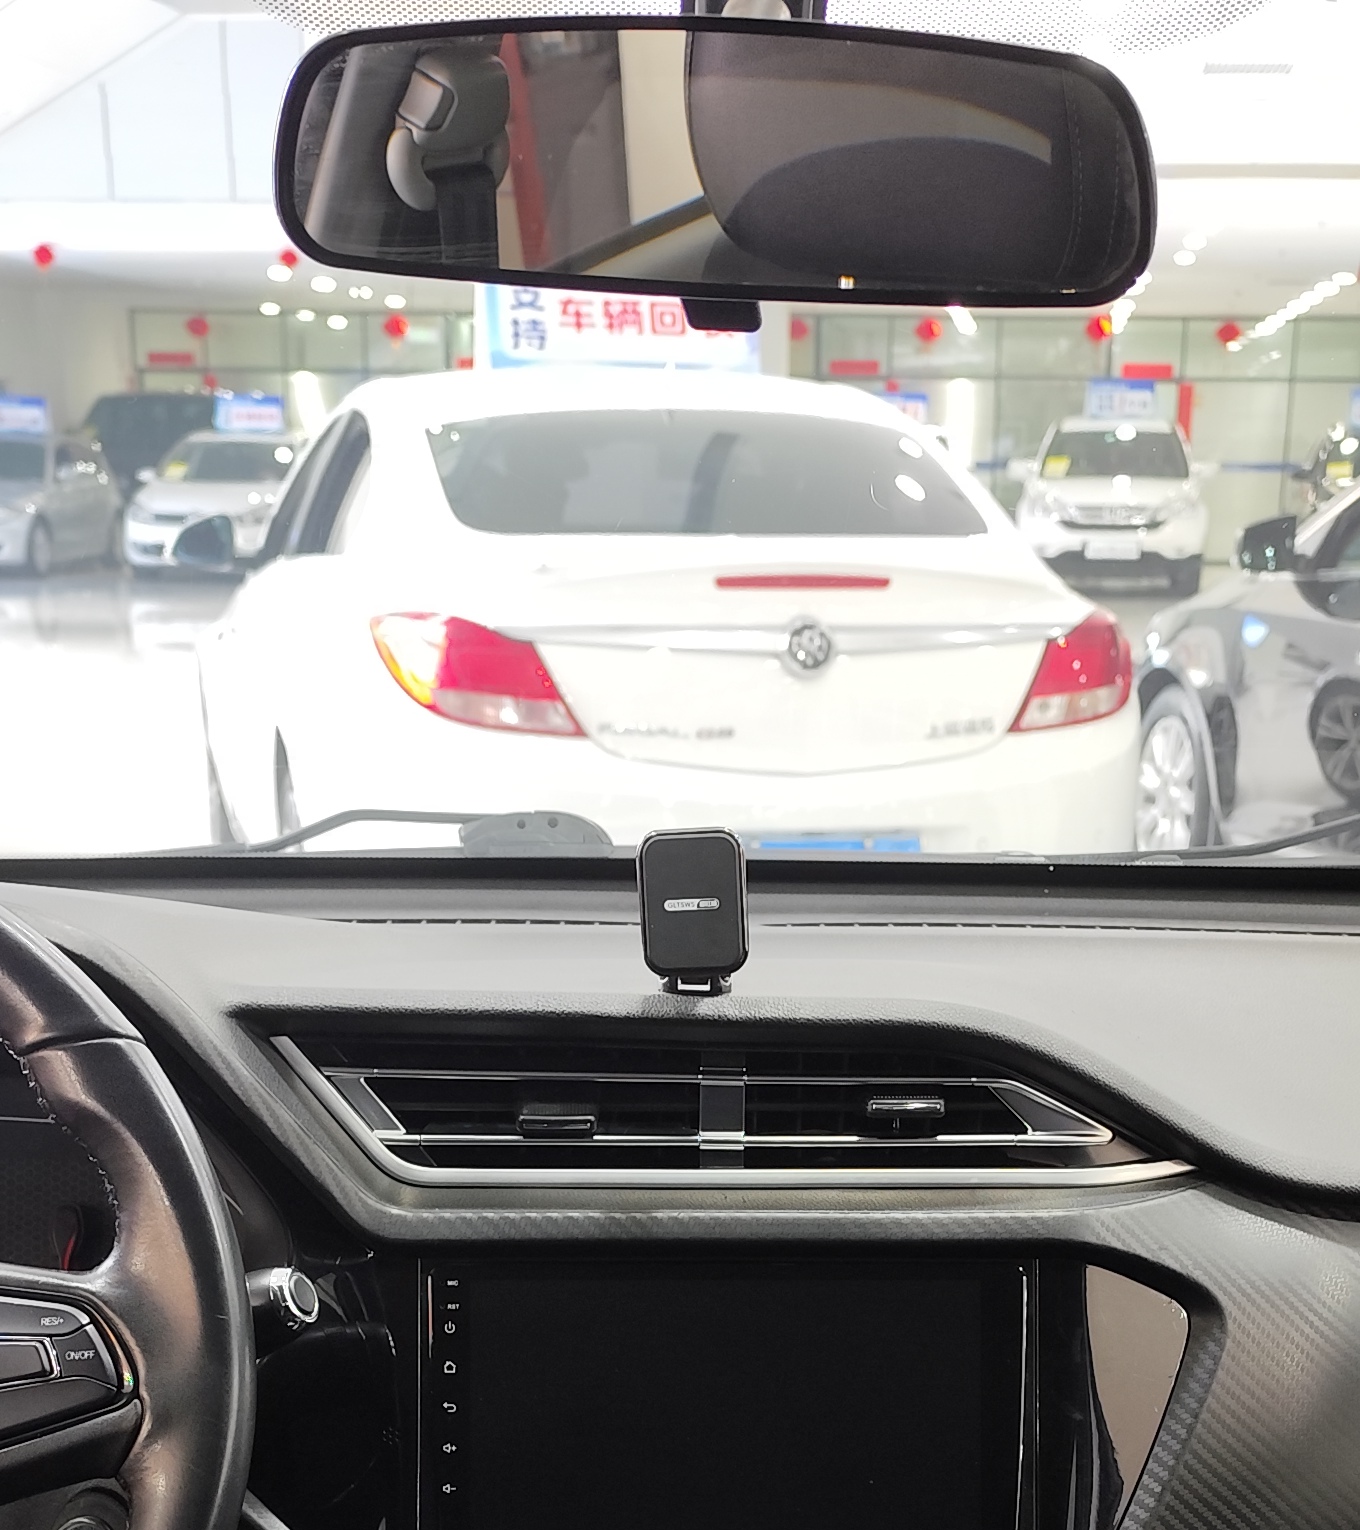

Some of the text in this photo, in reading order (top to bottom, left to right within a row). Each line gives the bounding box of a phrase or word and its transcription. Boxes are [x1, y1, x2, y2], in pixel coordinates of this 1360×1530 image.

[558, 297, 736, 338] 车辆回
[65, 1349, 96, 1361] ON/OFF
